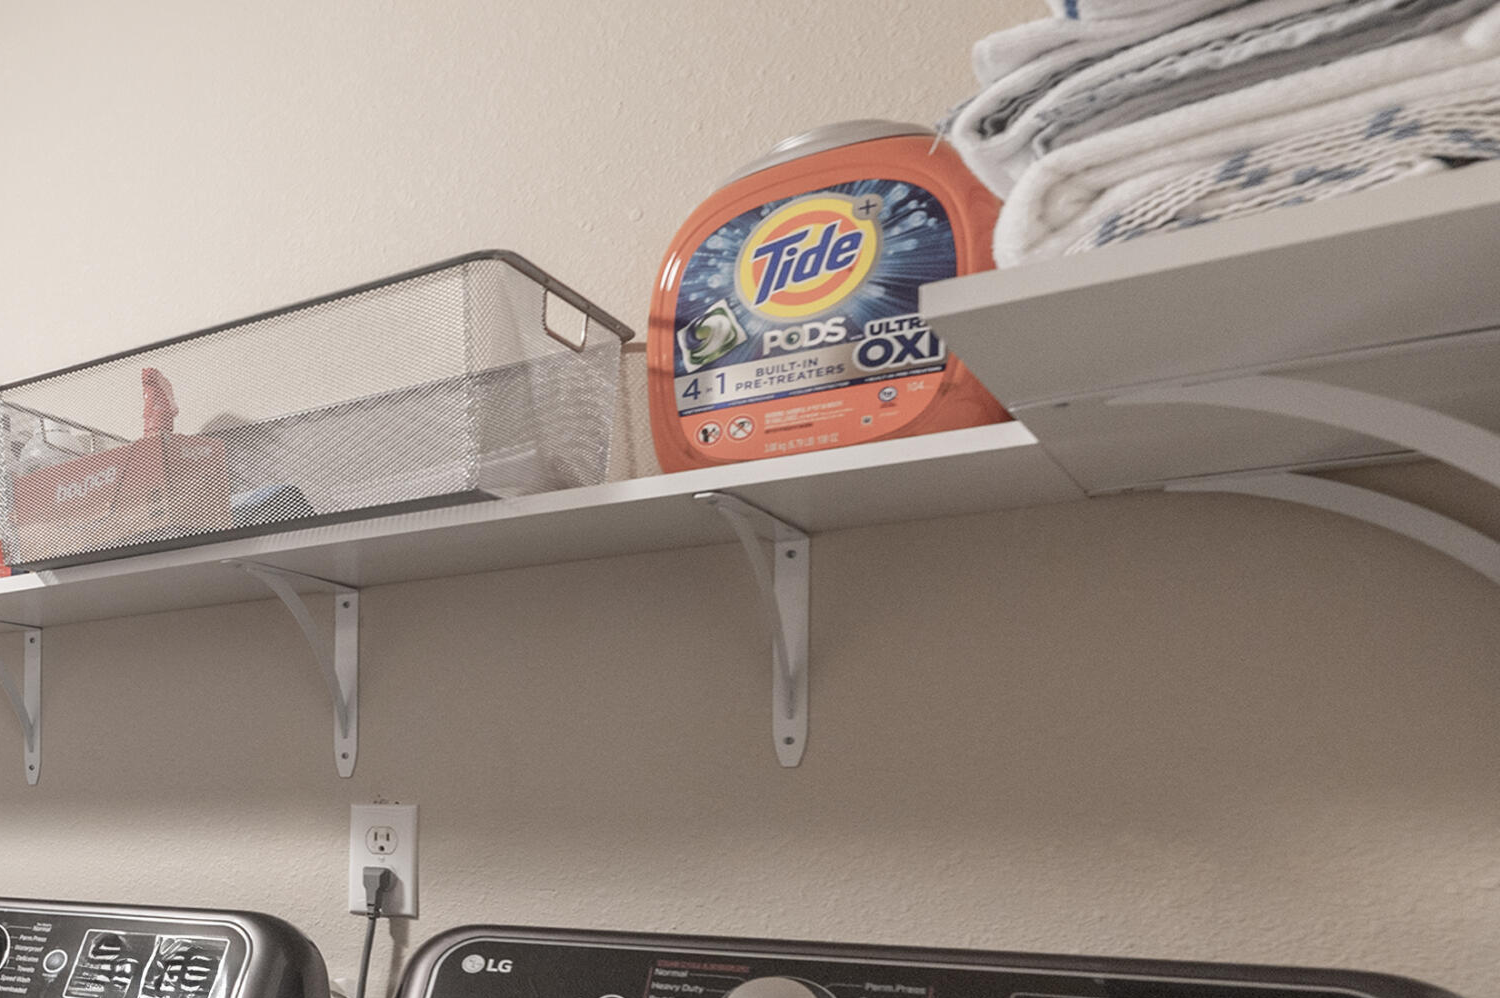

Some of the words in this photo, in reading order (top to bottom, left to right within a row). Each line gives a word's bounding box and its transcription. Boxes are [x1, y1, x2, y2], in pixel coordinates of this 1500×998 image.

[750, 220, 865, 308] Tide
[762, 316, 847, 356] PODS
[868, 316, 928, 336] ULTR
[857, 330, 940, 369] OXI
[735, 364, 846, 392] PRE-TREATERS
[755, 357, 819, 377] BUILT-IN
[682, 378, 701, 400] 4
[715, 373, 726, 395] 1
[485, 958, 514, 974] LG
[654, 968, 689, 978] Normal
[651, 981, 681, 992] Heavy
[681, 983, 705, 994] Duty
